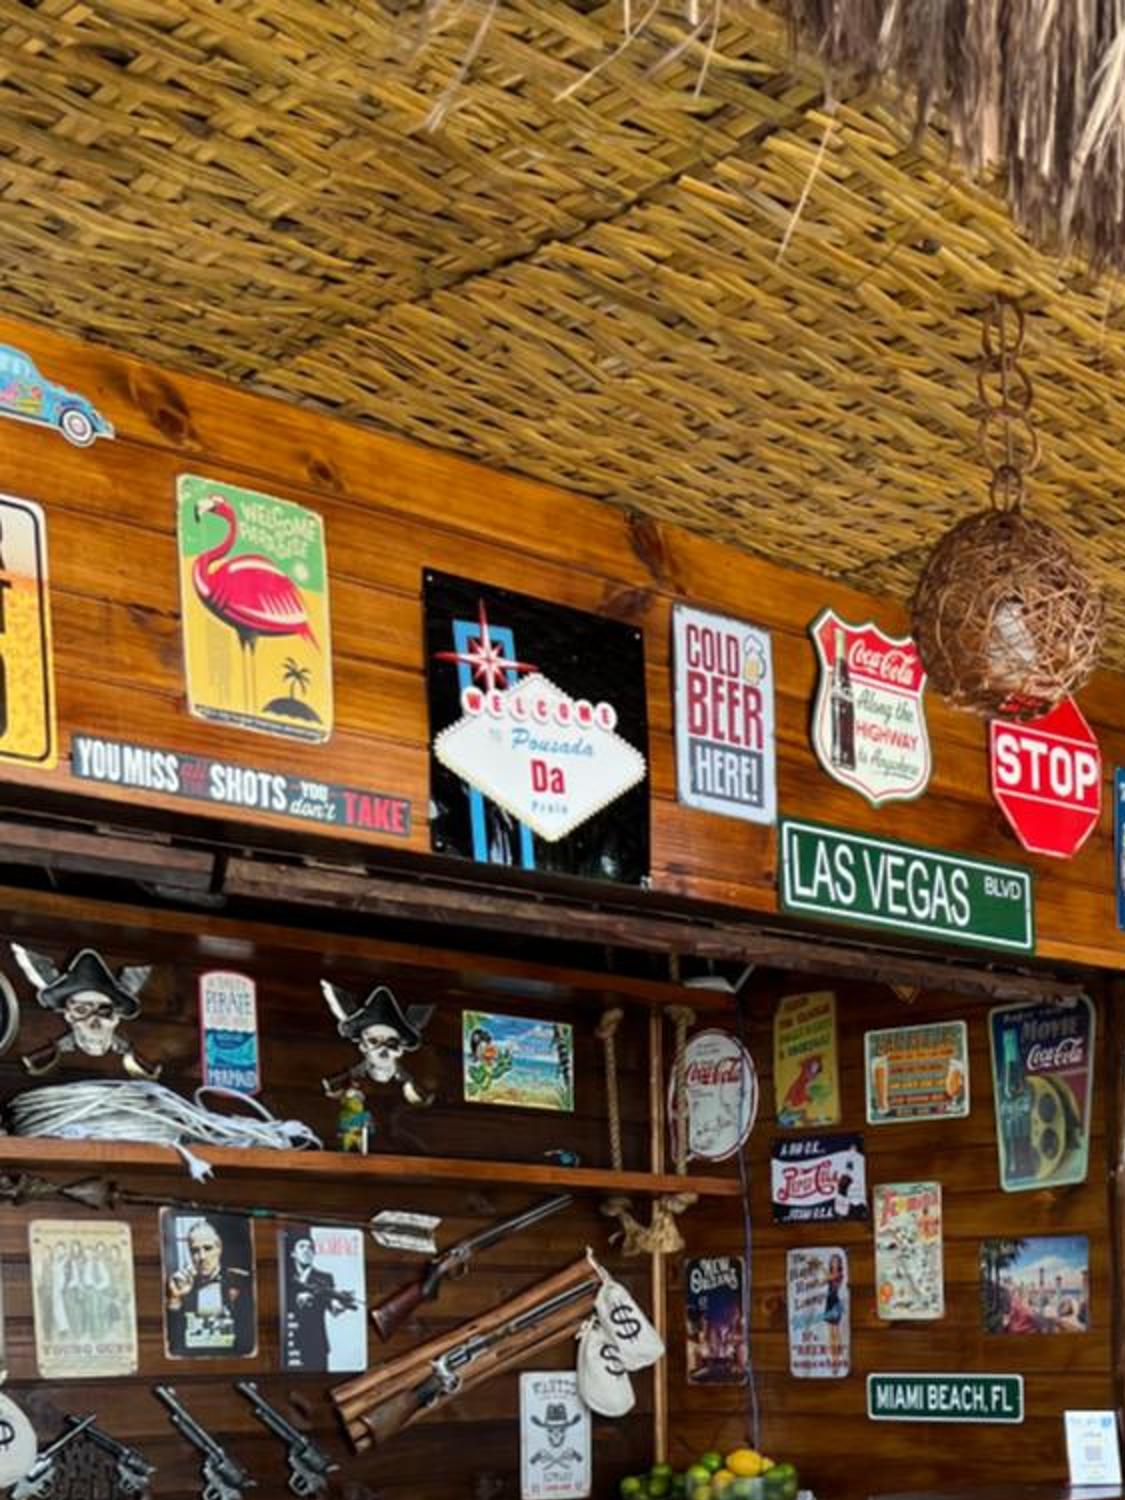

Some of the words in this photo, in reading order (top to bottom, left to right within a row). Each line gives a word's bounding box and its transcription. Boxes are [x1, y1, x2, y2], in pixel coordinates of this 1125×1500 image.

[686, 624, 741, 679] COLD
[464, 691, 614, 727] WELCOME
[687, 670, 764, 750] BEER
[511, 727, 595, 758] Pousada
[856, 721, 918, 751] HIGHWAY
[77, 737, 121, 782] YOU
[123, 746, 180, 793] MISS
[531, 759, 567, 795] Da
[696, 745, 760, 802] HERE!
[998, 734, 1100, 801] STOP
[209, 764, 288, 811] SHOTS
[300, 781, 330, 801] YOU
[289, 798, 337, 822] don't
[344, 790, 409, 834] TAKE
[791, 833, 856, 906] LAS
[862, 849, 972, 928] VEGAS
[983, 875, 1023, 900] BLVD
[875, 1384, 925, 1410] MIAMI
[990, 1385, 1014, 1412] FL
